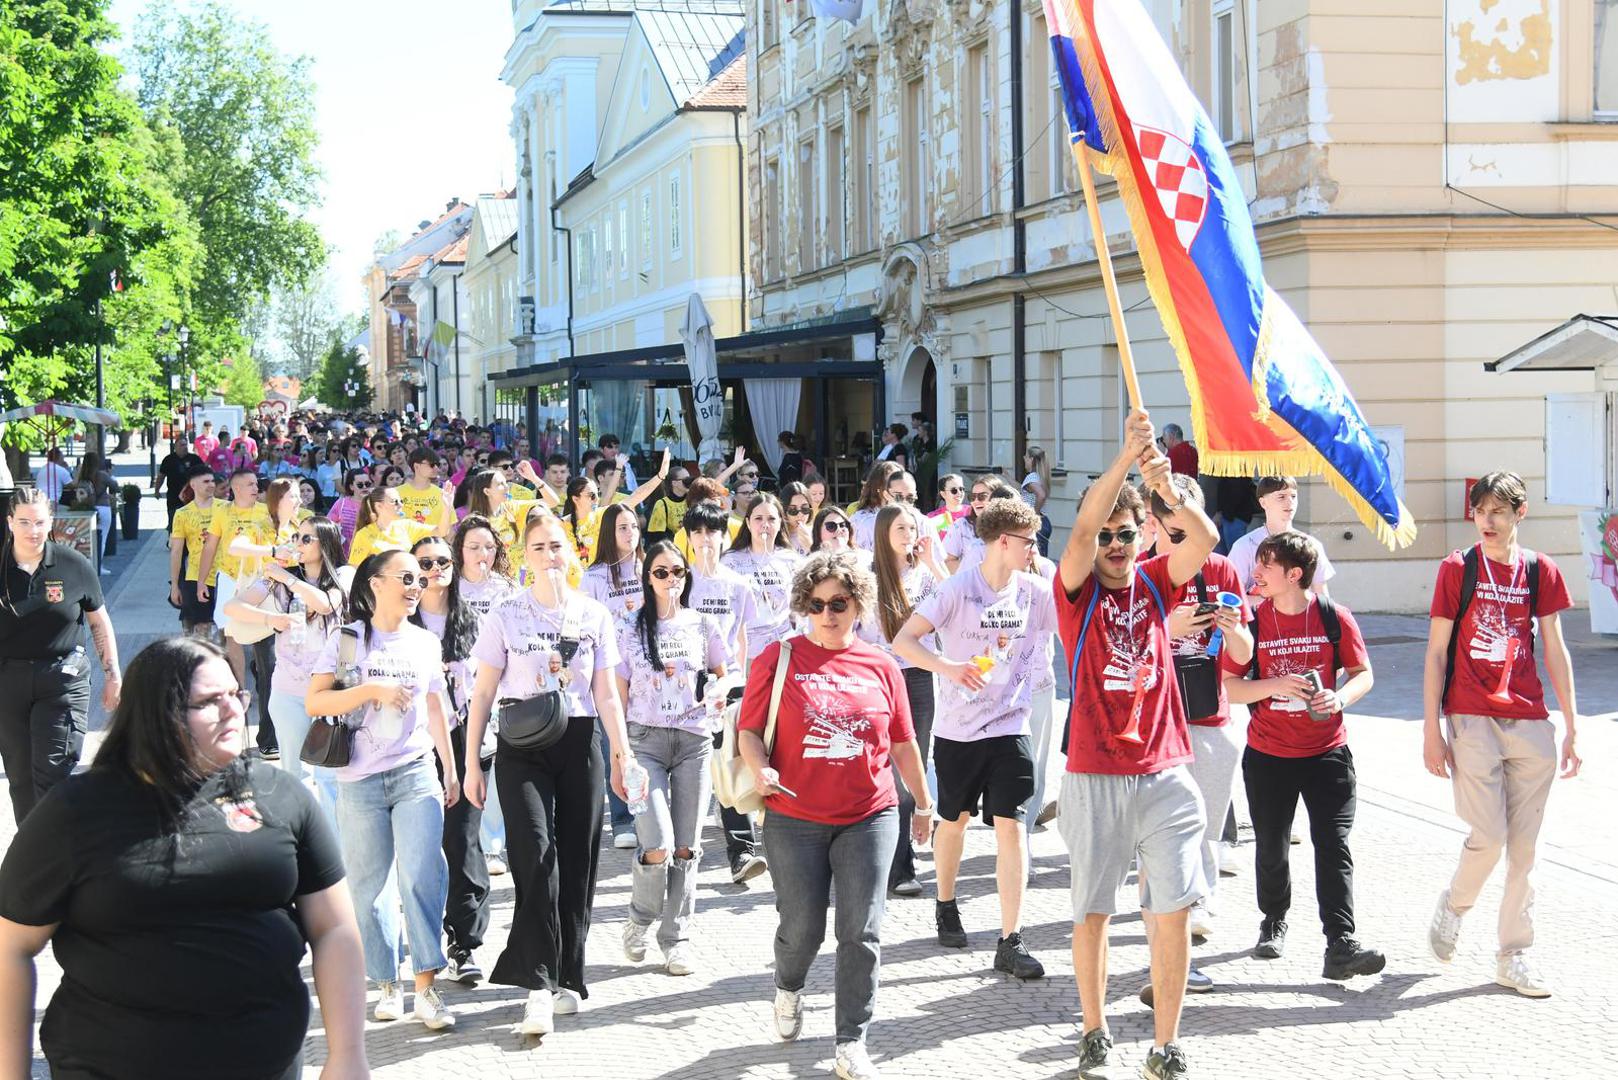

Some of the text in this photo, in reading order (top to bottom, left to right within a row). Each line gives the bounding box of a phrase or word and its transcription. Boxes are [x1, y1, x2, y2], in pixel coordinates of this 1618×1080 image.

[980, 621, 999, 629] KOLKO
[546, 633, 555, 641] MI
[1258, 638, 1289, 649] OSTAVITE
[1289, 637, 1313, 646] SVAKU
[1269, 645, 1321, 657] VI KOJI ULAZITE
